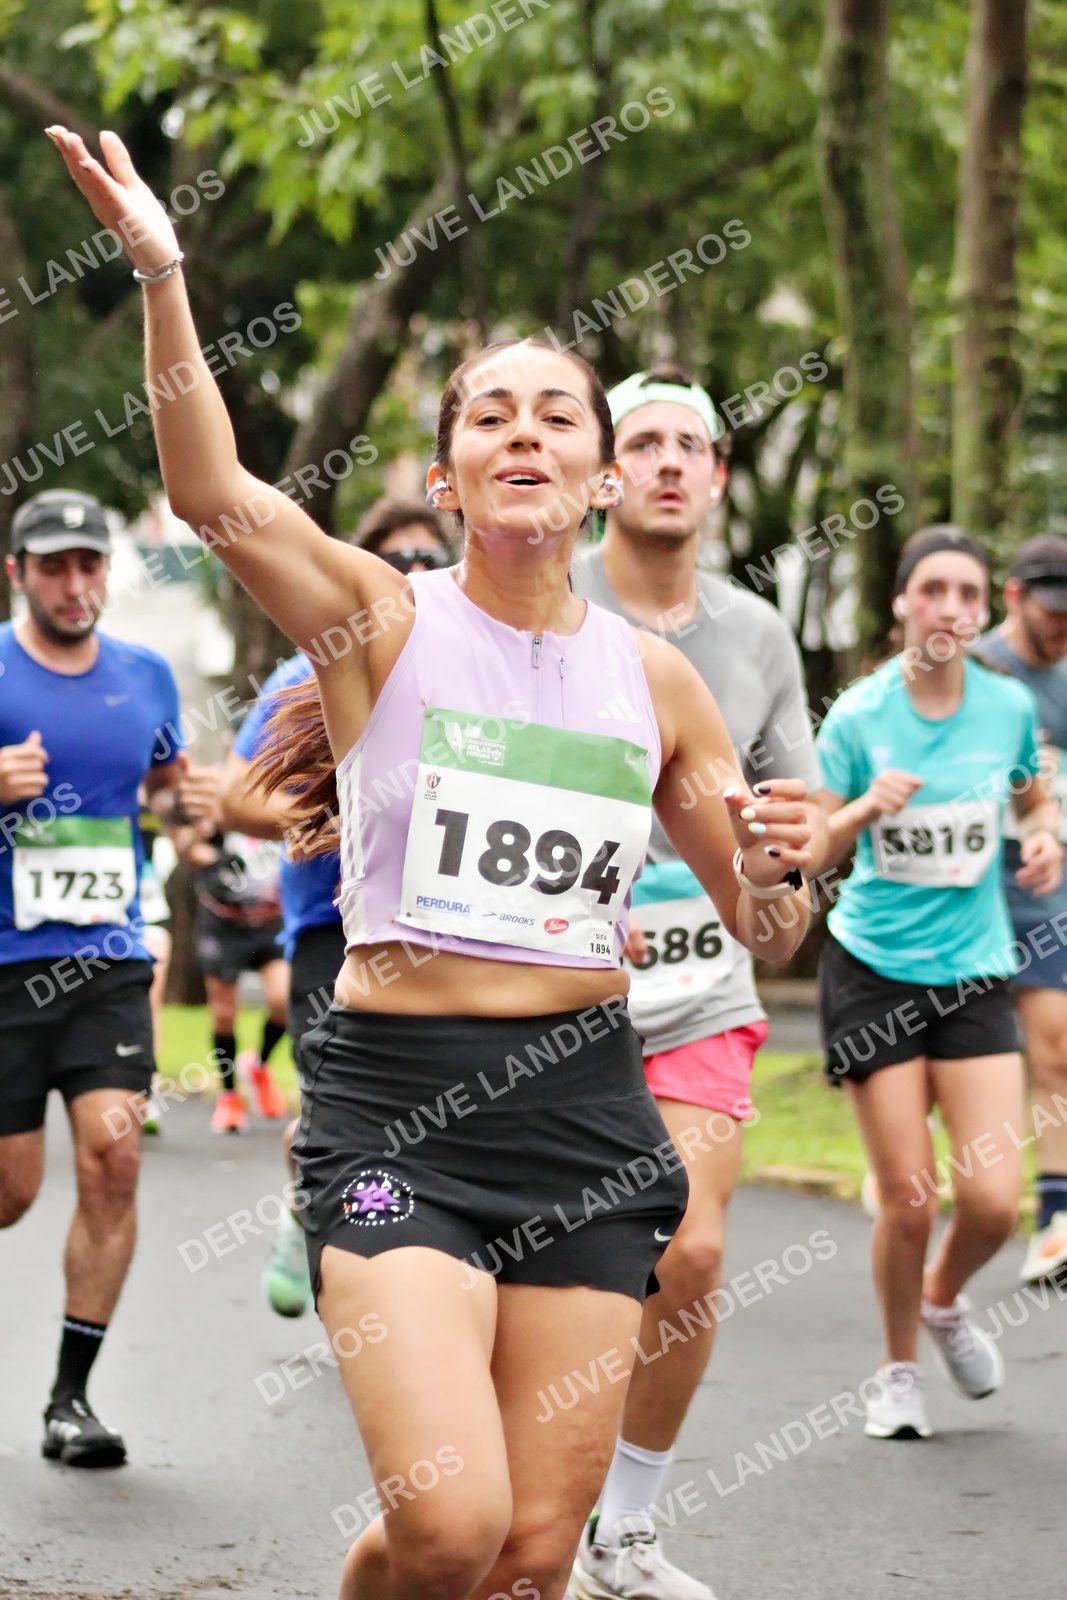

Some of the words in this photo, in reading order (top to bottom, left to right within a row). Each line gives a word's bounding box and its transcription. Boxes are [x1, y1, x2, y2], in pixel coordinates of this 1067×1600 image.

[434, 808, 621, 905] 1894
[29, 870, 124, 900] 1723
[416, 895, 471, 914] PERDURA
[499, 913, 536, 926] BROOKS
[590, 942, 611, 955] 1894
